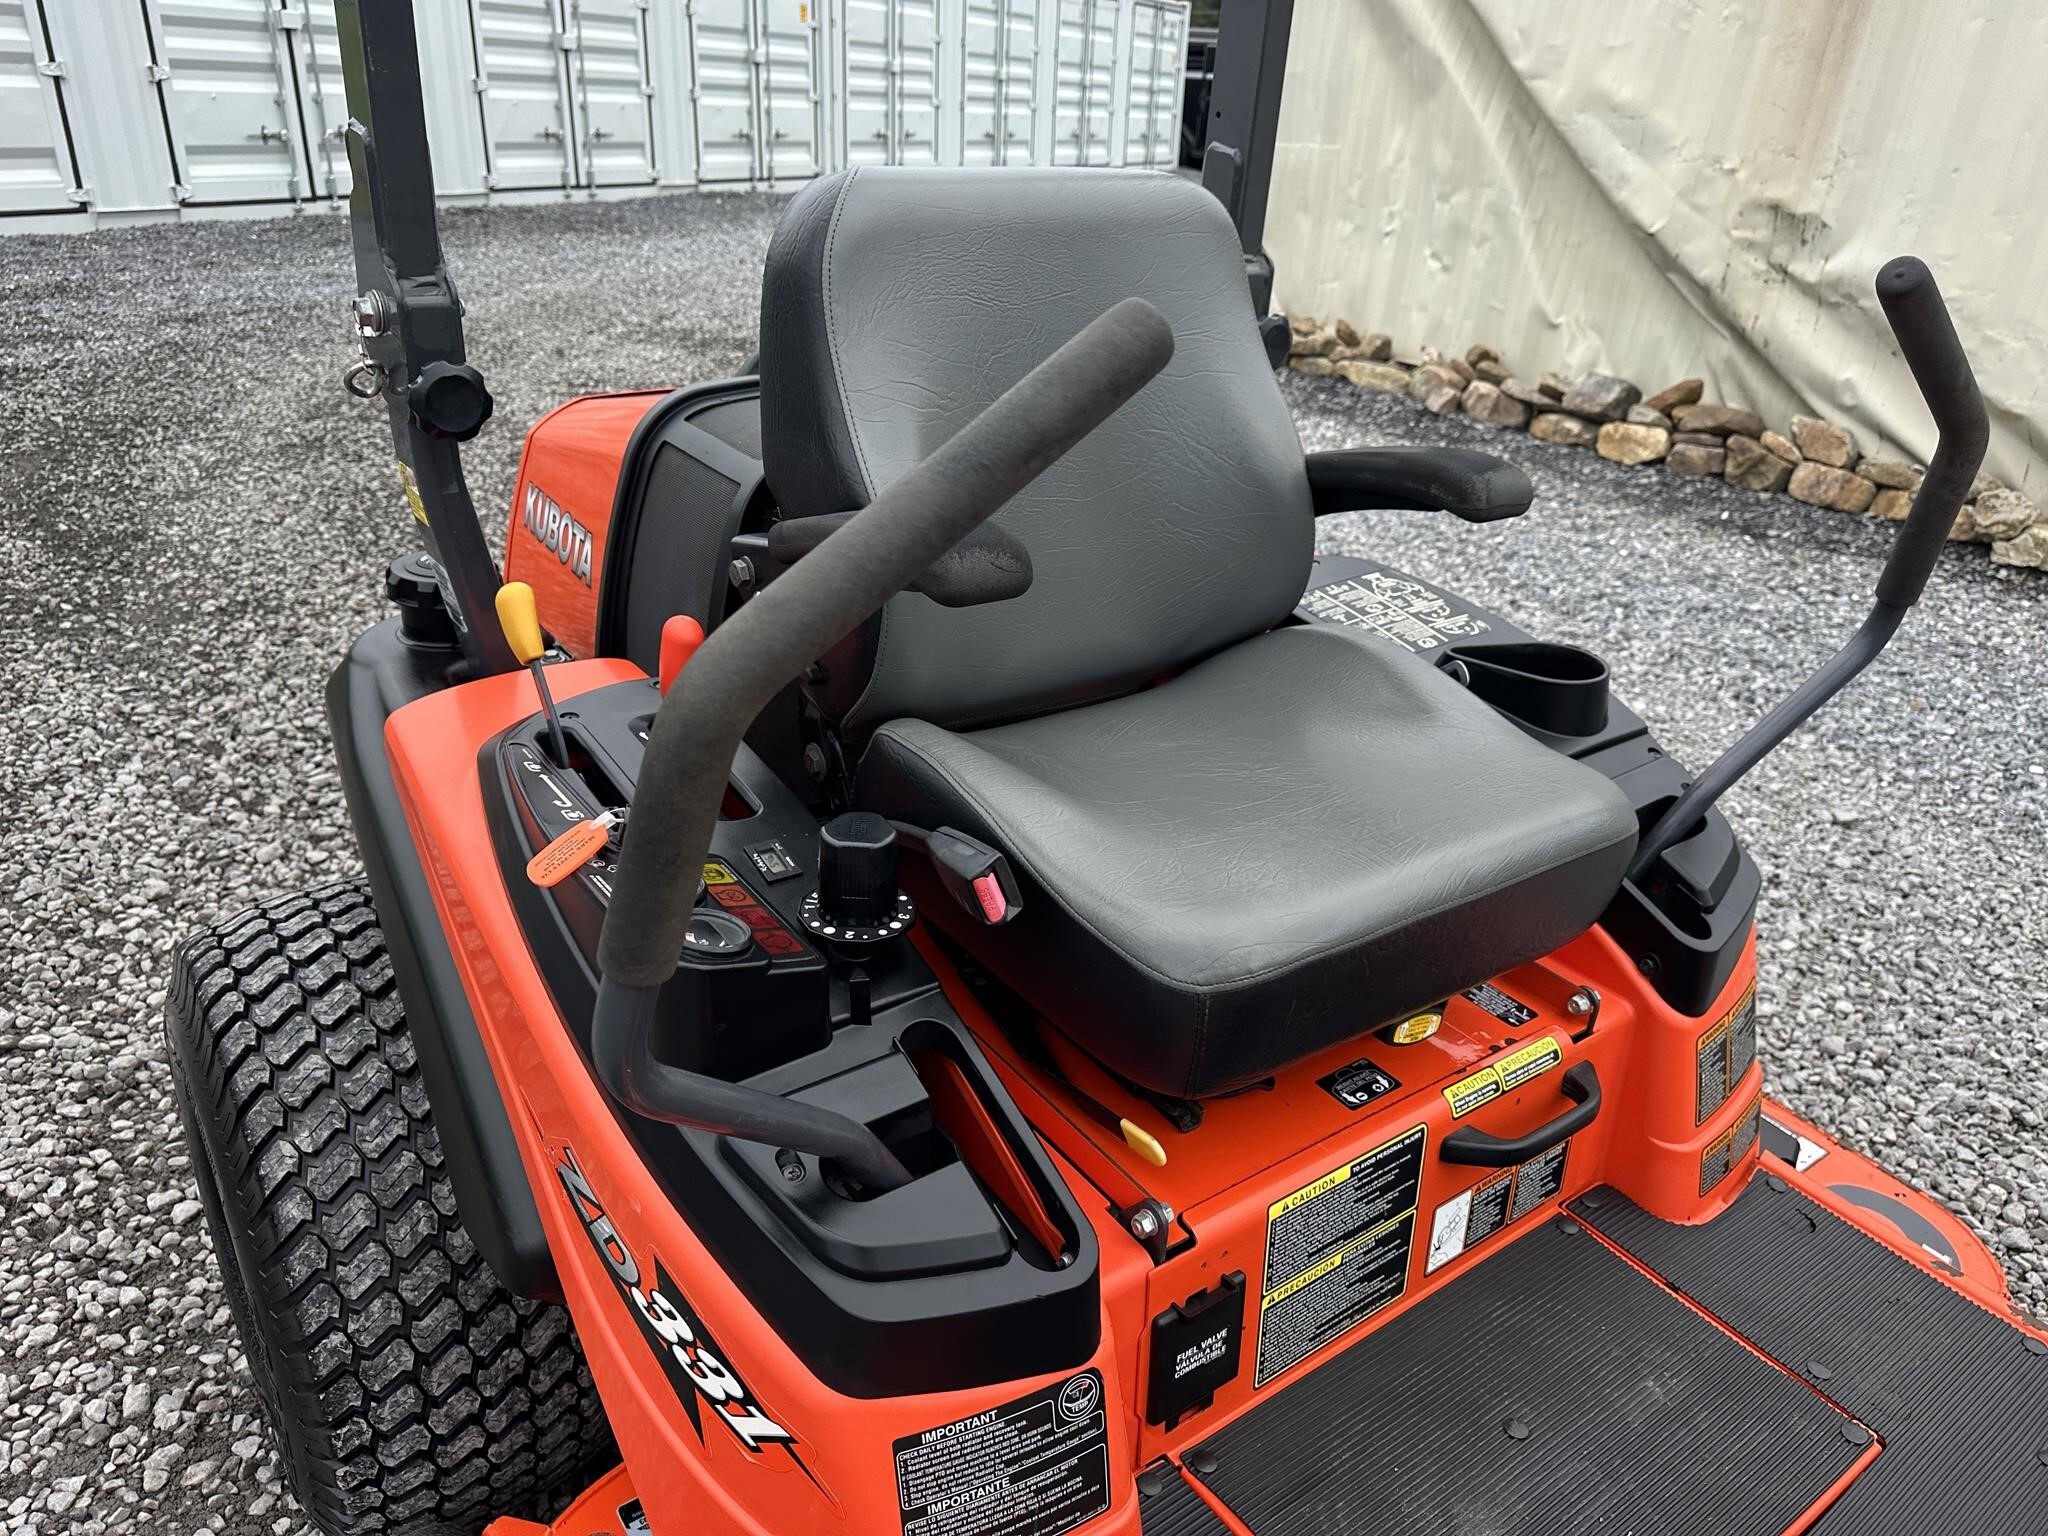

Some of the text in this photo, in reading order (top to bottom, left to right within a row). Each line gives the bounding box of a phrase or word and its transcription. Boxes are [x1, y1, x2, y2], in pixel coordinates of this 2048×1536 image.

[524, 480, 593, 589] KUBOTA
[845, 931, 855, 939] 2
[1456, 1070, 1495, 1094] CAUTION
[1377, 1142, 1404, 1160] PERSONAL
[1292, 1176, 1336, 1206] CAUTION
[1277, 1260, 1335, 1299] PRECAUCIÓN
[558, 1147, 797, 1451] ZD331
[1177, 1328, 1228, 1363] FUEL VALVE
[1212, 1339, 1223, 1351] DE
[1175, 1344, 1226, 1379] COMBUSTIBLE
[1072, 1401, 1088, 1413] TEMP
[922, 1409, 998, 1445] IMPORTANT
[900, 1451, 918, 1461] CHECK
[919, 1445, 935, 1455] DAILY
[936, 1438, 957, 1449] BEFORE
[958, 1429, 985, 1442] STARTING
[929, 1450, 942, 1459] level
[928, 1477, 1010, 1515] IMPORTANTE
[908, 1519, 927, 1530] REVISE
